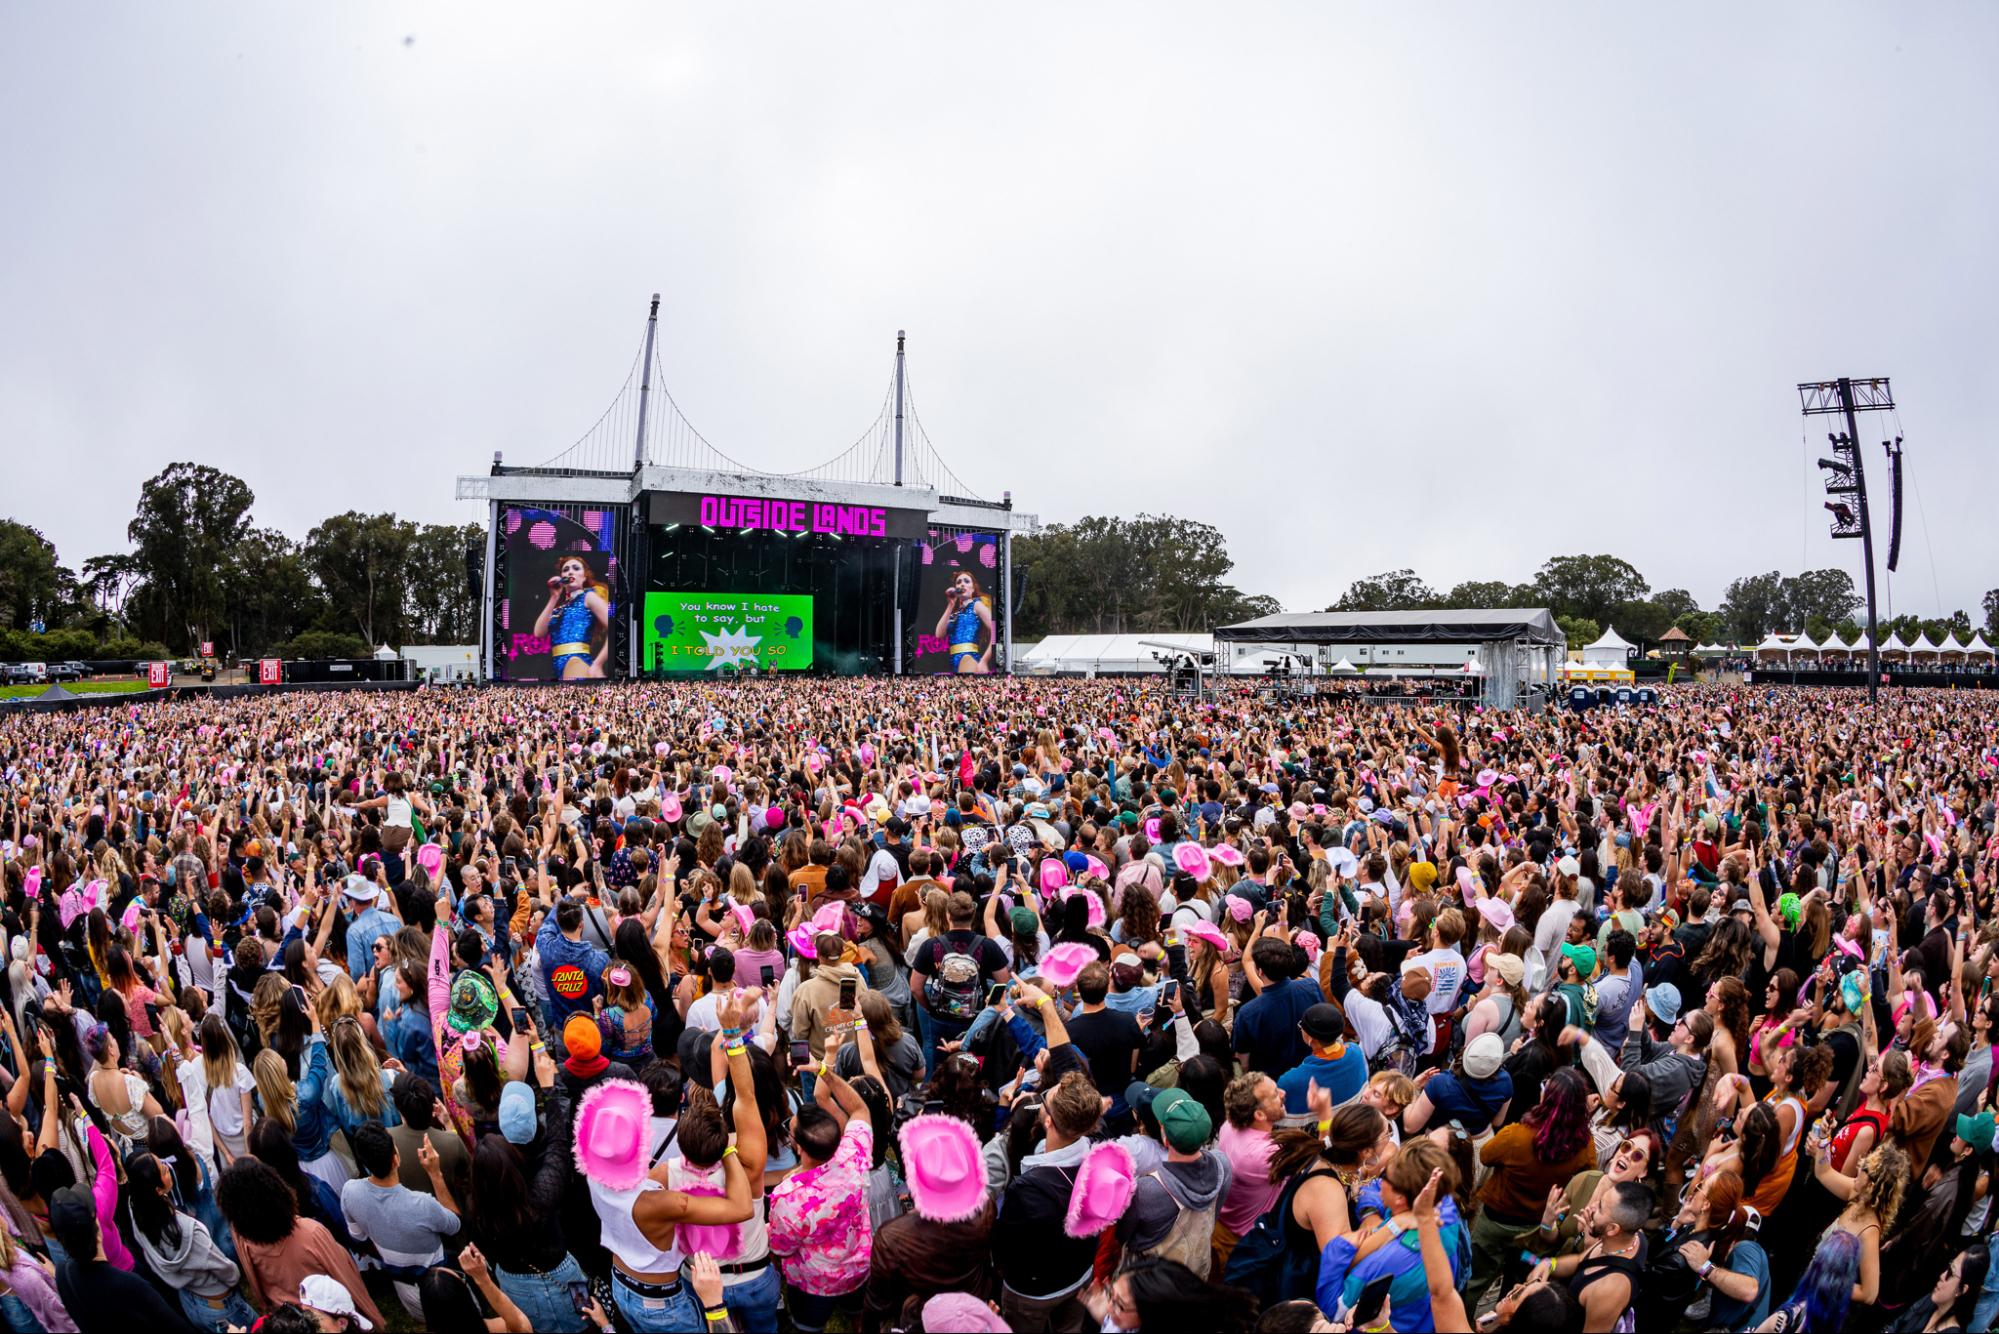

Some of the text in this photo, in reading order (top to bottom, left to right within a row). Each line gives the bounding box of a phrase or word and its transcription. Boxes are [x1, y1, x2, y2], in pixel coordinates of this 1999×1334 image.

[701, 496, 886, 537] OUTSIDE LANDS
[680, 601, 780, 612] You know I hate
[694, 614, 765, 625] to say, but
[671, 645, 787, 656] I TOLD YOU SO
[151, 670, 165, 683] EXIT
[263, 666, 278, 681] EXIT
[551, 970, 584, 981] SANTA
[557, 982, 583, 992] CRUZ
